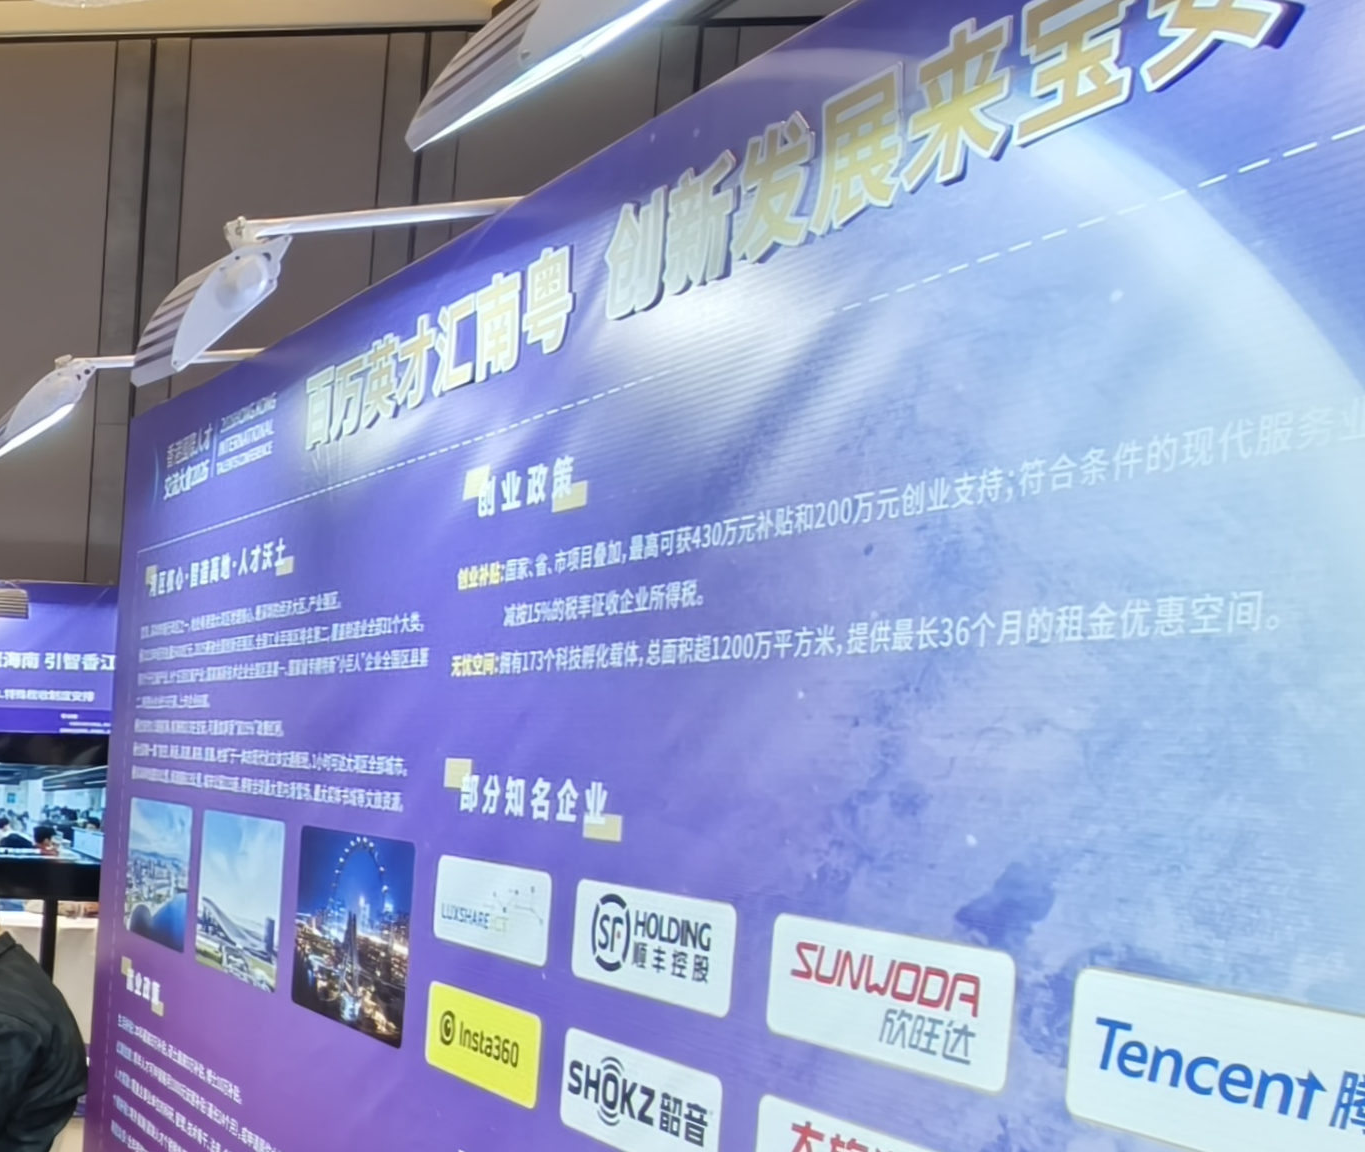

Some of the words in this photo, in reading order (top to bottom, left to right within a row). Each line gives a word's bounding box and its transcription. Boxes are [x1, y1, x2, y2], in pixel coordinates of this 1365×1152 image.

[305, 244, 575, 453] 百万英才汇南粤
[478, 456, 575, 518] 创业政策
[460, 773, 608, 825] 部分知名企业
[441, 902, 491, 930] LUXSHARE
[634, 909, 712, 951] HOLDING
[790, 940, 981, 1018] SUNWODA
[459, 1020, 520, 1069] Insta360
[879, 1008, 976, 1066] 欣旺达
[1095, 1015, 1328, 1122] Tencent
[567, 1058, 656, 1126] SHOKZ
[659, 1091, 709, 1148] 韶音
